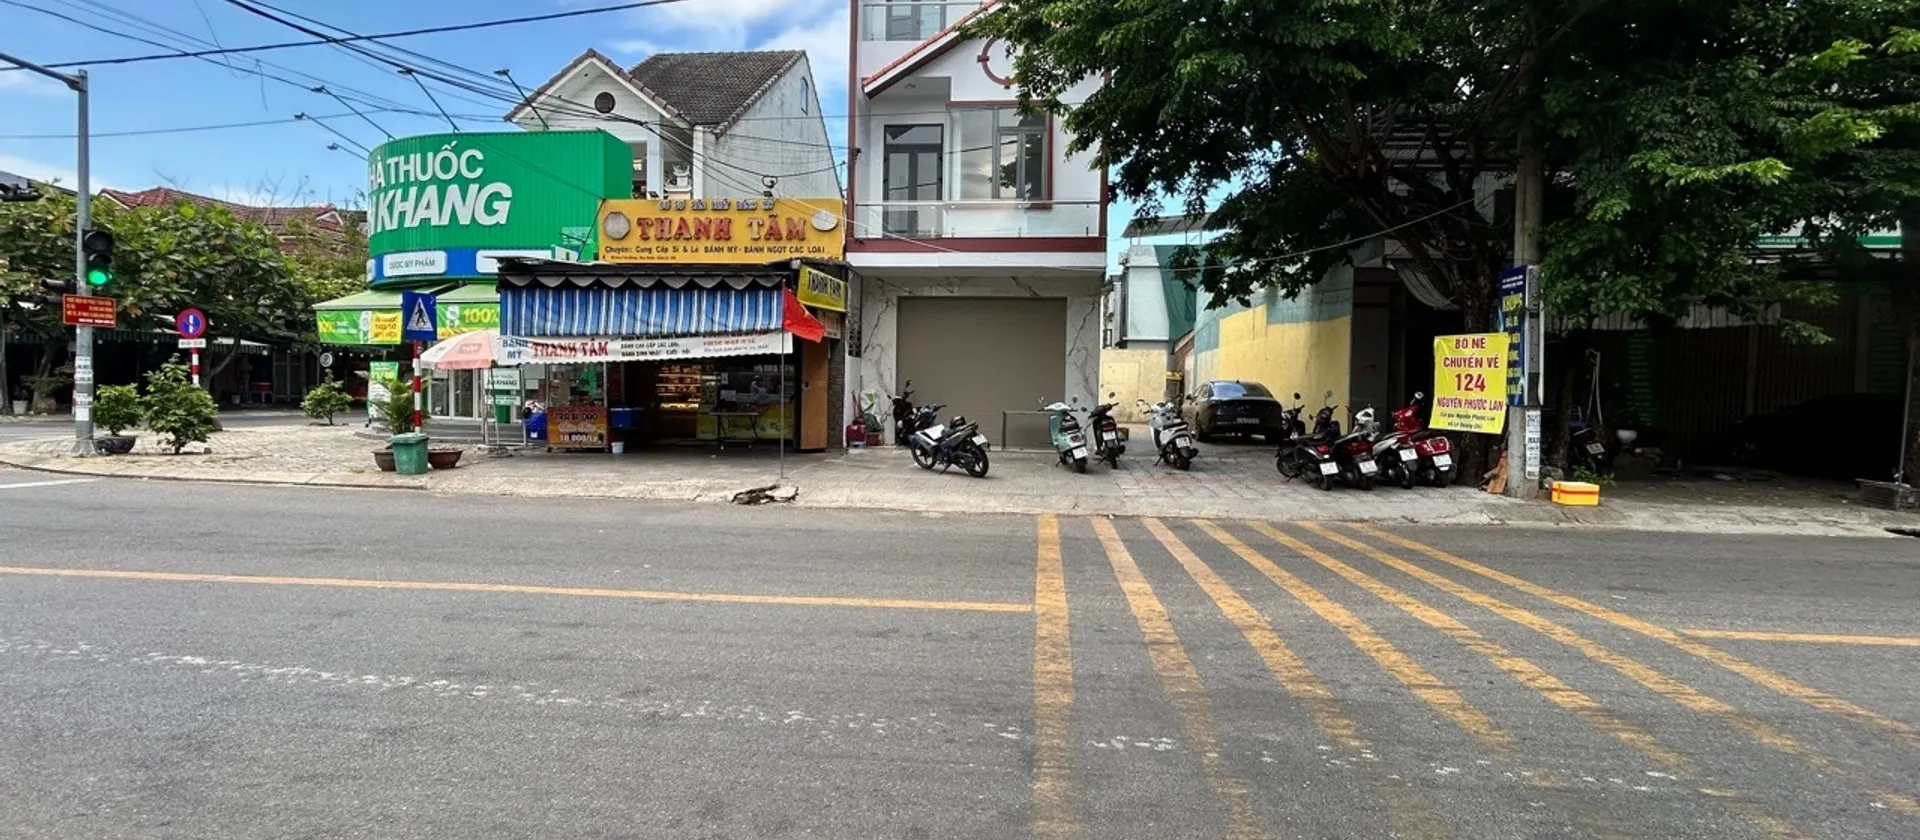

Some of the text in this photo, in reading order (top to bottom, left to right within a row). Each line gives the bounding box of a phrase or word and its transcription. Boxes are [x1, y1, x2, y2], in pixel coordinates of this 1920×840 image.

[386, 140, 485, 186] THUỐC
[375, 182, 513, 233] KHANG
[636, 216, 732, 242] THANH
[635, 245, 652, 255] Cung
[704, 244, 724, 254] BÁNH
[744, 244, 765, 254] BÁNH
[1455, 373, 1486, 391] 124
[1489, 400, 1504, 411] LAN
